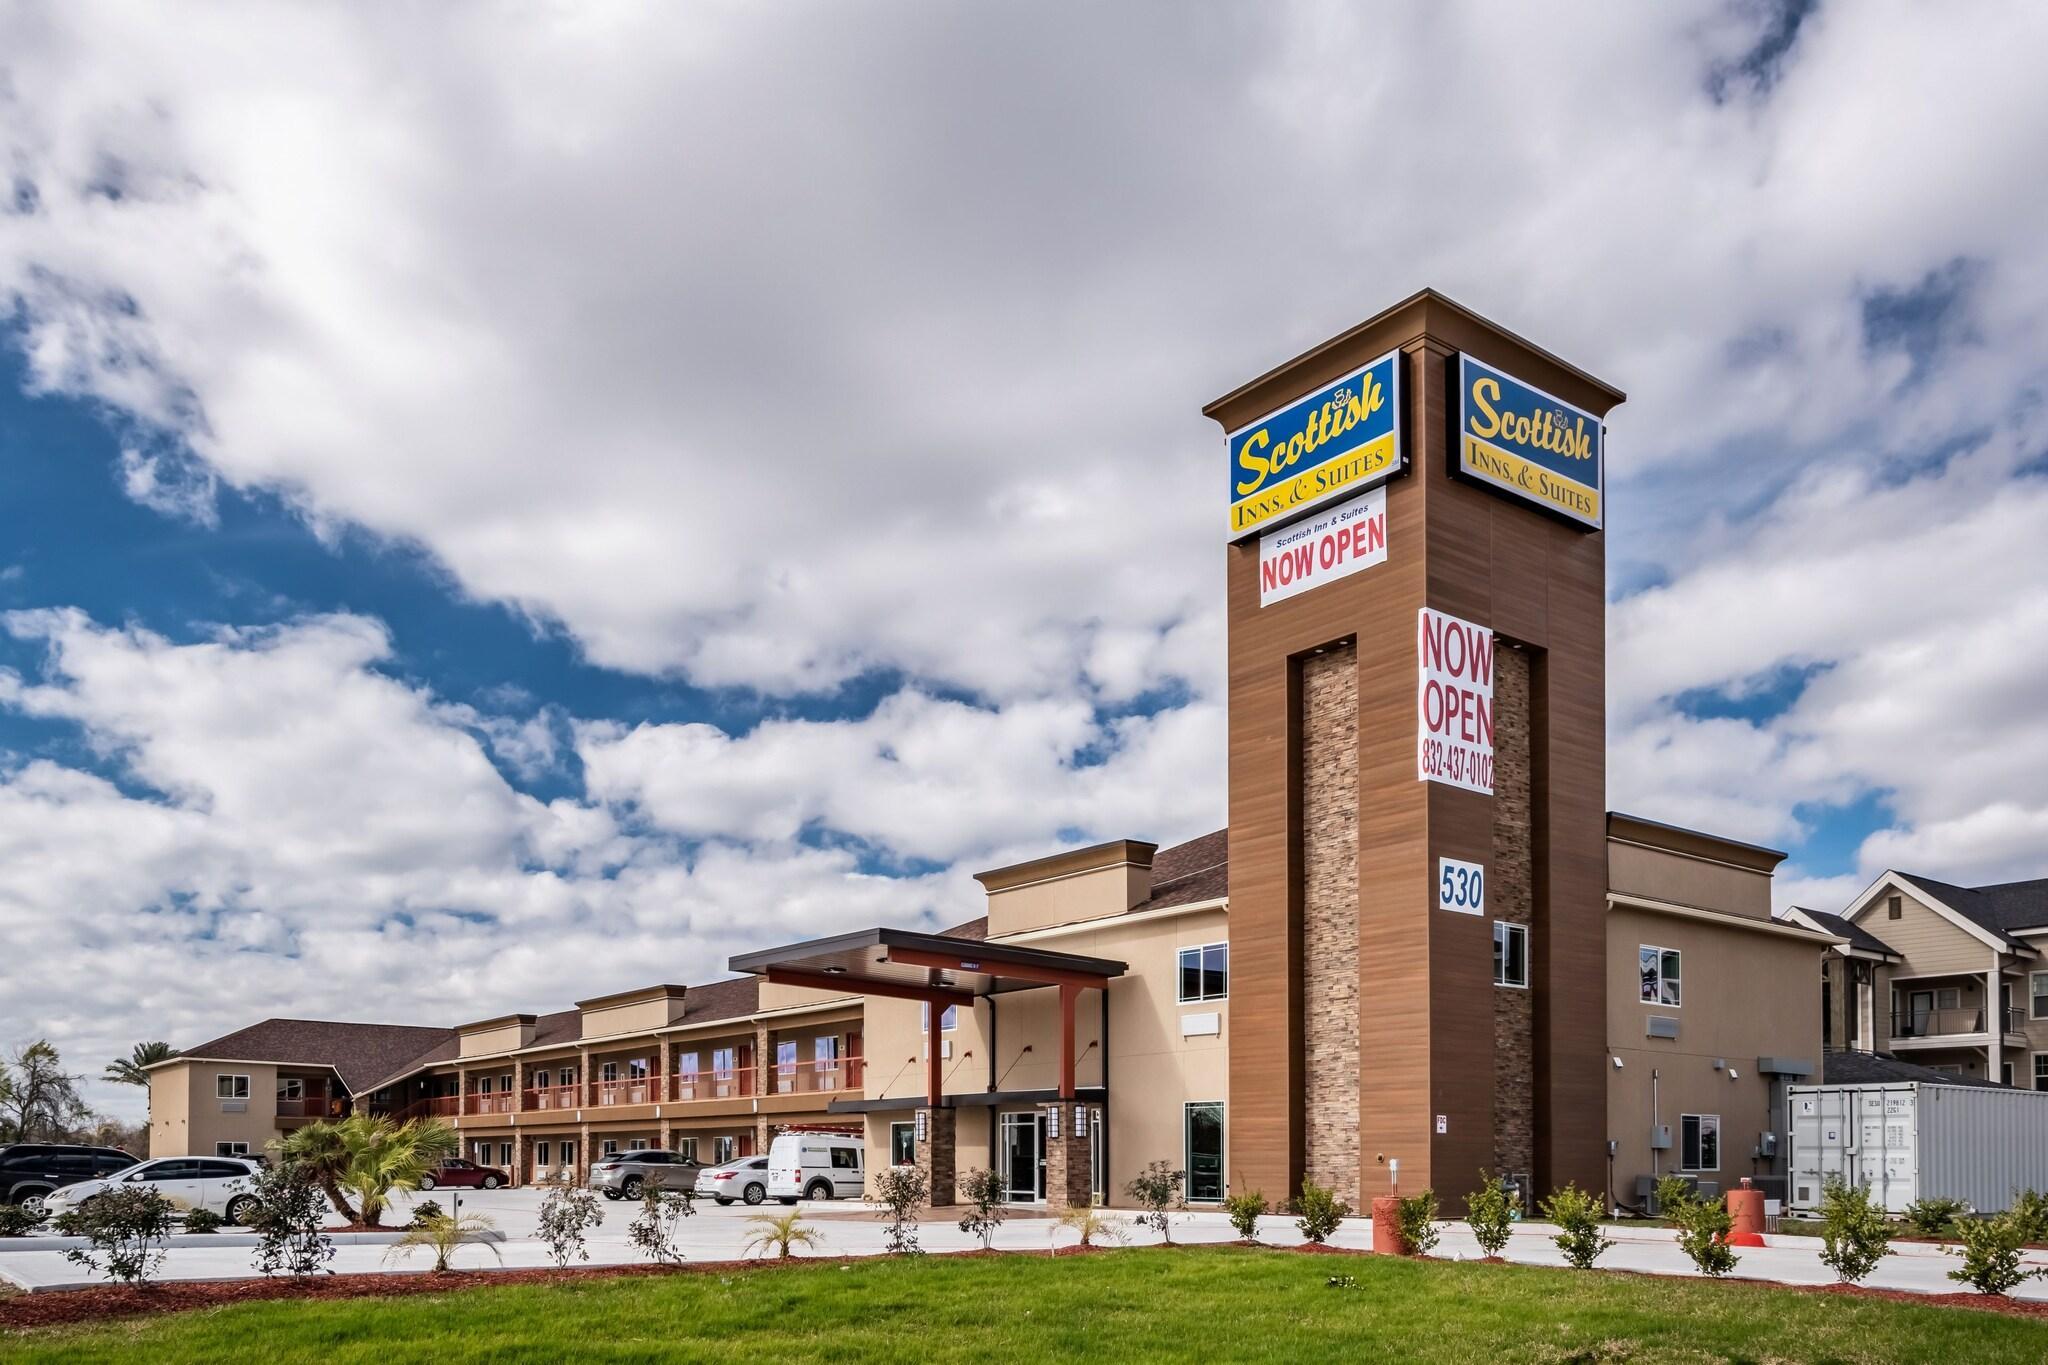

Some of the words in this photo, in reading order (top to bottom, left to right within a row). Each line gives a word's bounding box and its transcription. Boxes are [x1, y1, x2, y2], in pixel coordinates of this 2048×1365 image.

[1236, 371, 1385, 495] Scottish
[1470, 377, 1592, 460] Scottish
[1289, 479, 1308, 504] &
[1315, 448, 1384, 494] SUITES
[1518, 464, 1534, 490] &
[1539, 473, 1591, 513] SUITES
[1262, 541, 1315, 593] NOW
[1319, 513, 1385, 571] OPEN
[1276, 527, 1312, 549] Scottish
[1314, 522, 1328, 533] Inn
[1331, 516, 1338, 526] &
[1340, 504, 1369, 522] Suites
[1422, 612, 1494, 686] NOW
[1423, 679, 1494, 748] OPEN
[1422, 738, 1495, 790] 832-437-0102
[1441, 865, 1483, 909] 530
